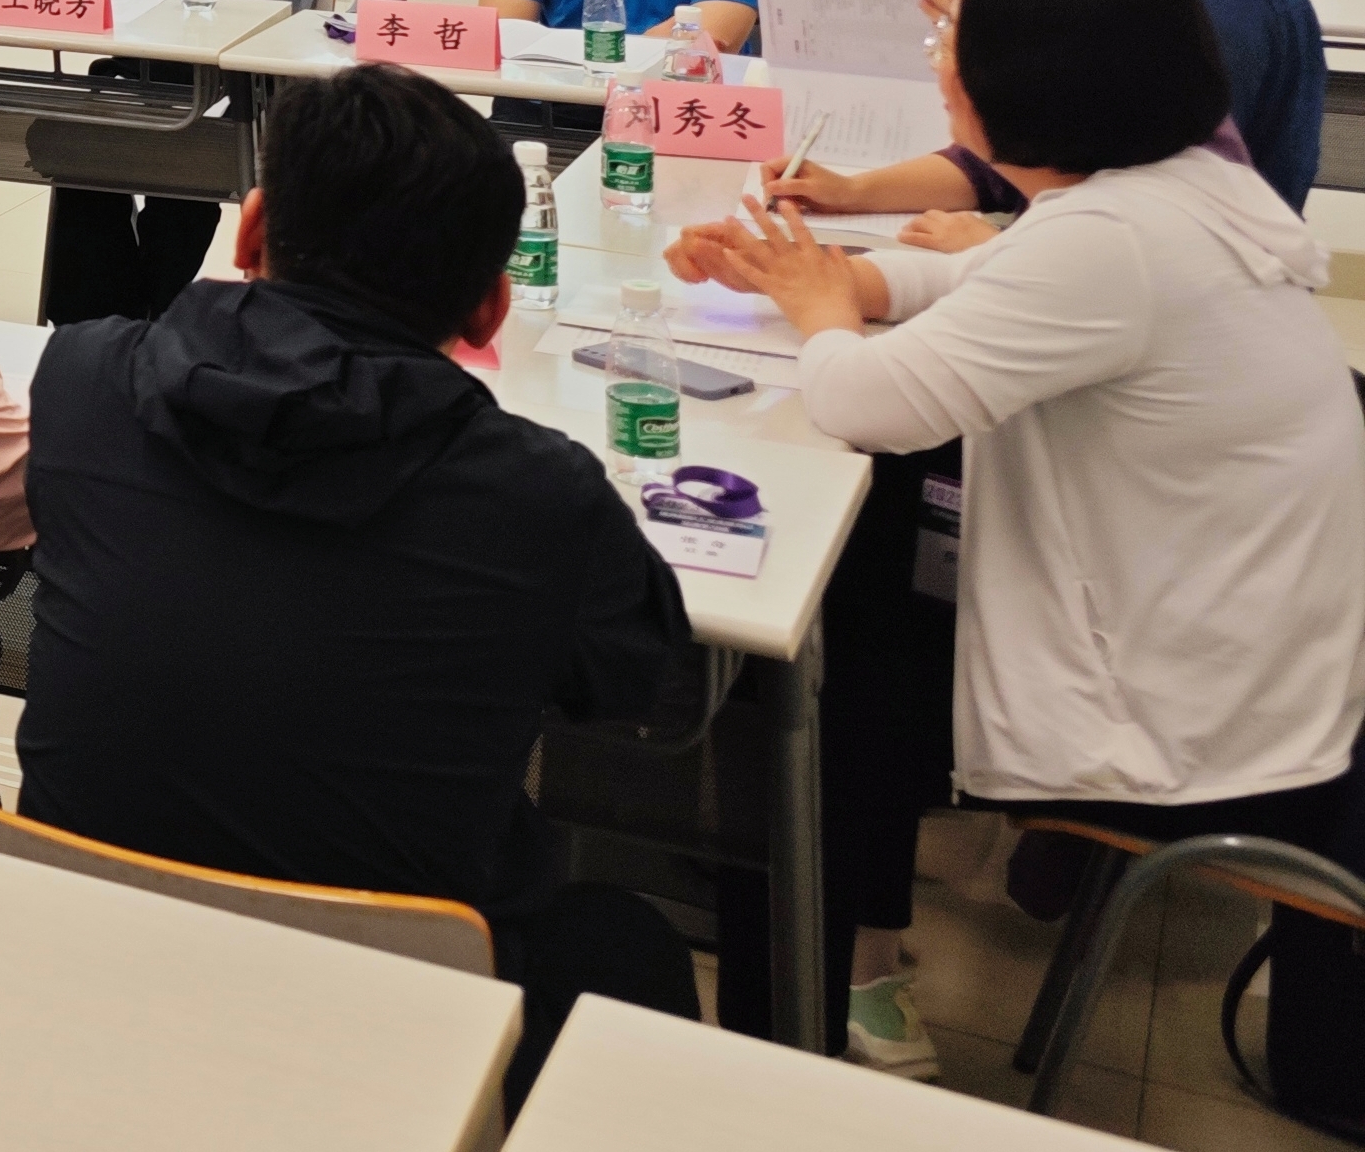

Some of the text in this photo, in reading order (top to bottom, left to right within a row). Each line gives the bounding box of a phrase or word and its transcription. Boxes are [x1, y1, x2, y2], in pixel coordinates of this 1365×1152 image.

[377, 13, 468, 51] 李哲
[625, 96, 767, 139] 刘秀冬
